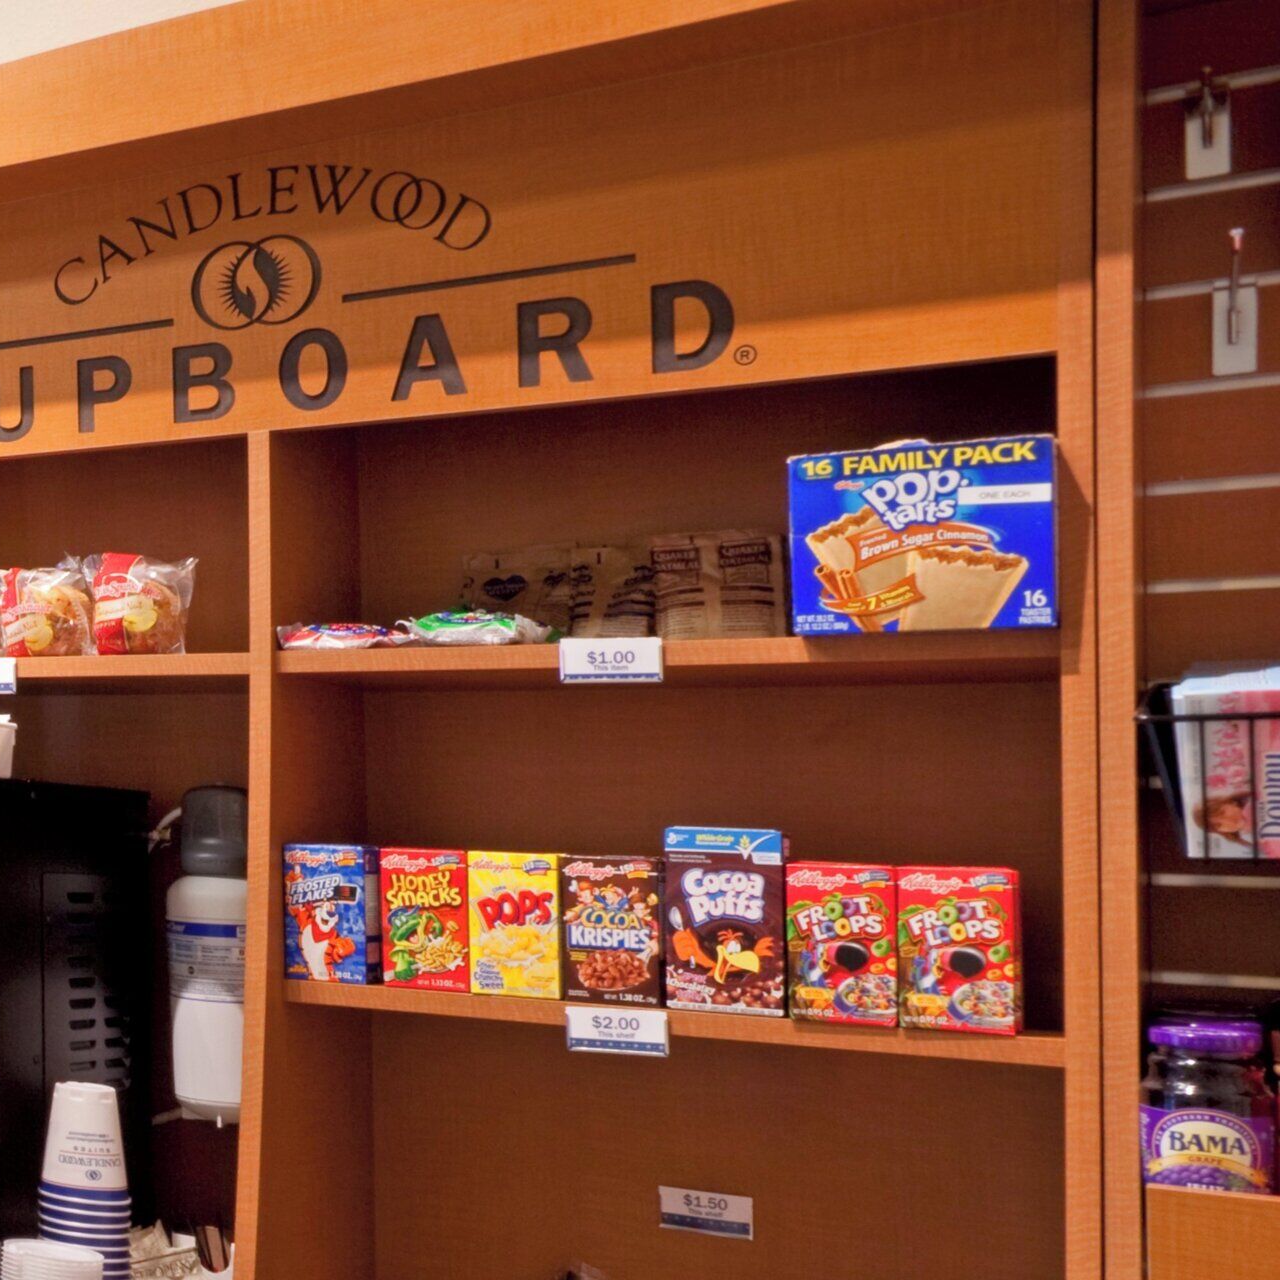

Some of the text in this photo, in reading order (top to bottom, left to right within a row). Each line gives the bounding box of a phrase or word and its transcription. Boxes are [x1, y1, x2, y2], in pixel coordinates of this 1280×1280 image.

[53, 164, 492, 306] CANDLEWOOD
[802, 440, 1037, 477] 16 FAMILY PACK
[978, 488, 1032, 500] ONE EACH
[860, 528, 989, 561] Brown Sugar Cinnamon
[866, 597, 878, 611] 7
[1022, 589, 1048, 607] 16
[586, 650, 636, 666] $1.00
[381, 854, 428, 872] Kellogg's
[563, 860, 615, 881] Kellogg's
[290, 876, 340, 895] FROSTED
[391, 871, 451, 893] HONEY
[683, 868, 765, 898] Cocoa
[788, 870, 847, 890] Kellogg's
[900, 873, 963, 894] Kellogg's
[291, 887, 336, 904] FLAKES
[386, 887, 462, 909] SMACKS
[477, 889, 554, 931] POPS
[688, 890, 765, 925] Puffs
[796, 896, 871, 930] FROOT
[909, 899, 989, 936] FROOT
[580, 908, 641, 929] COCOA
[811, 914, 885, 942] LOOPS
[570, 925, 651, 948] KRISPIES
[925, 918, 1002, 946] LOOPS
[591, 1014, 640, 1032] $2.00
[597, 1031, 635, 1040] This shelf
[1168, 1130, 1247, 1156] BAMA
[683, 1193, 728, 1212] $1.50
